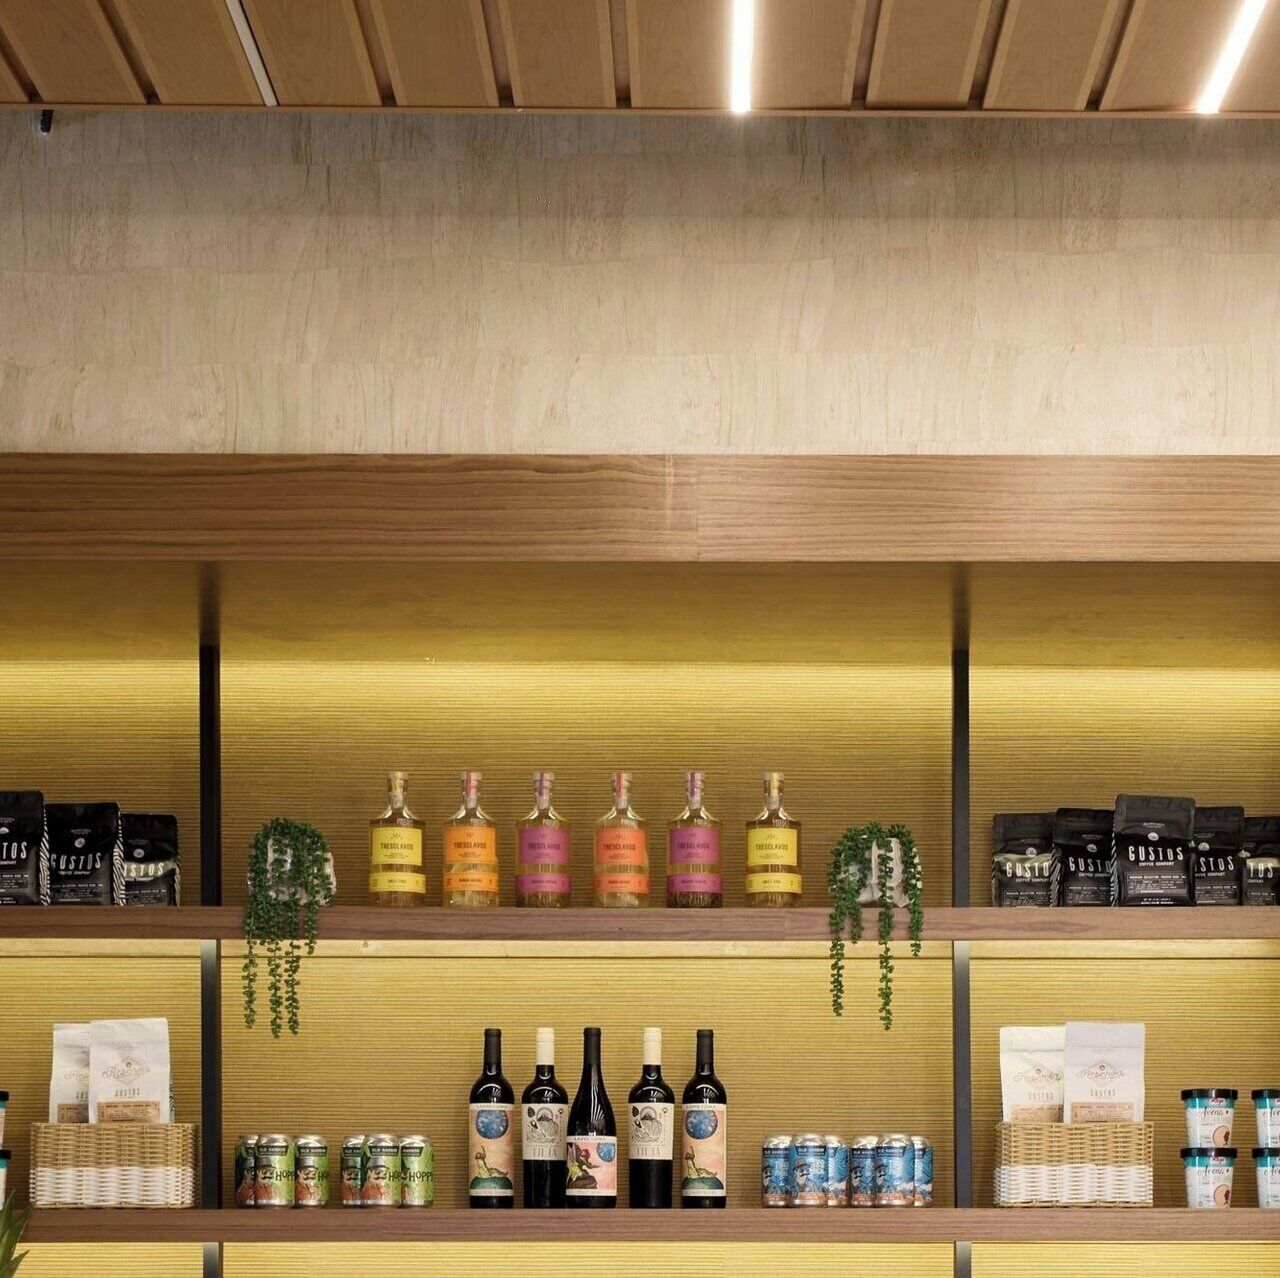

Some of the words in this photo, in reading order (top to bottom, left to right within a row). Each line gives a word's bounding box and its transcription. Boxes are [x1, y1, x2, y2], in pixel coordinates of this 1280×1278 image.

[1128, 845, 1184, 862] GUSTOS
[124, 862, 164, 878] STOS
[1006, 862, 1050, 878] GUSTO
[1069, 856, 1111, 872] GUSTO
[1195, 855, 1235, 873] STOS
